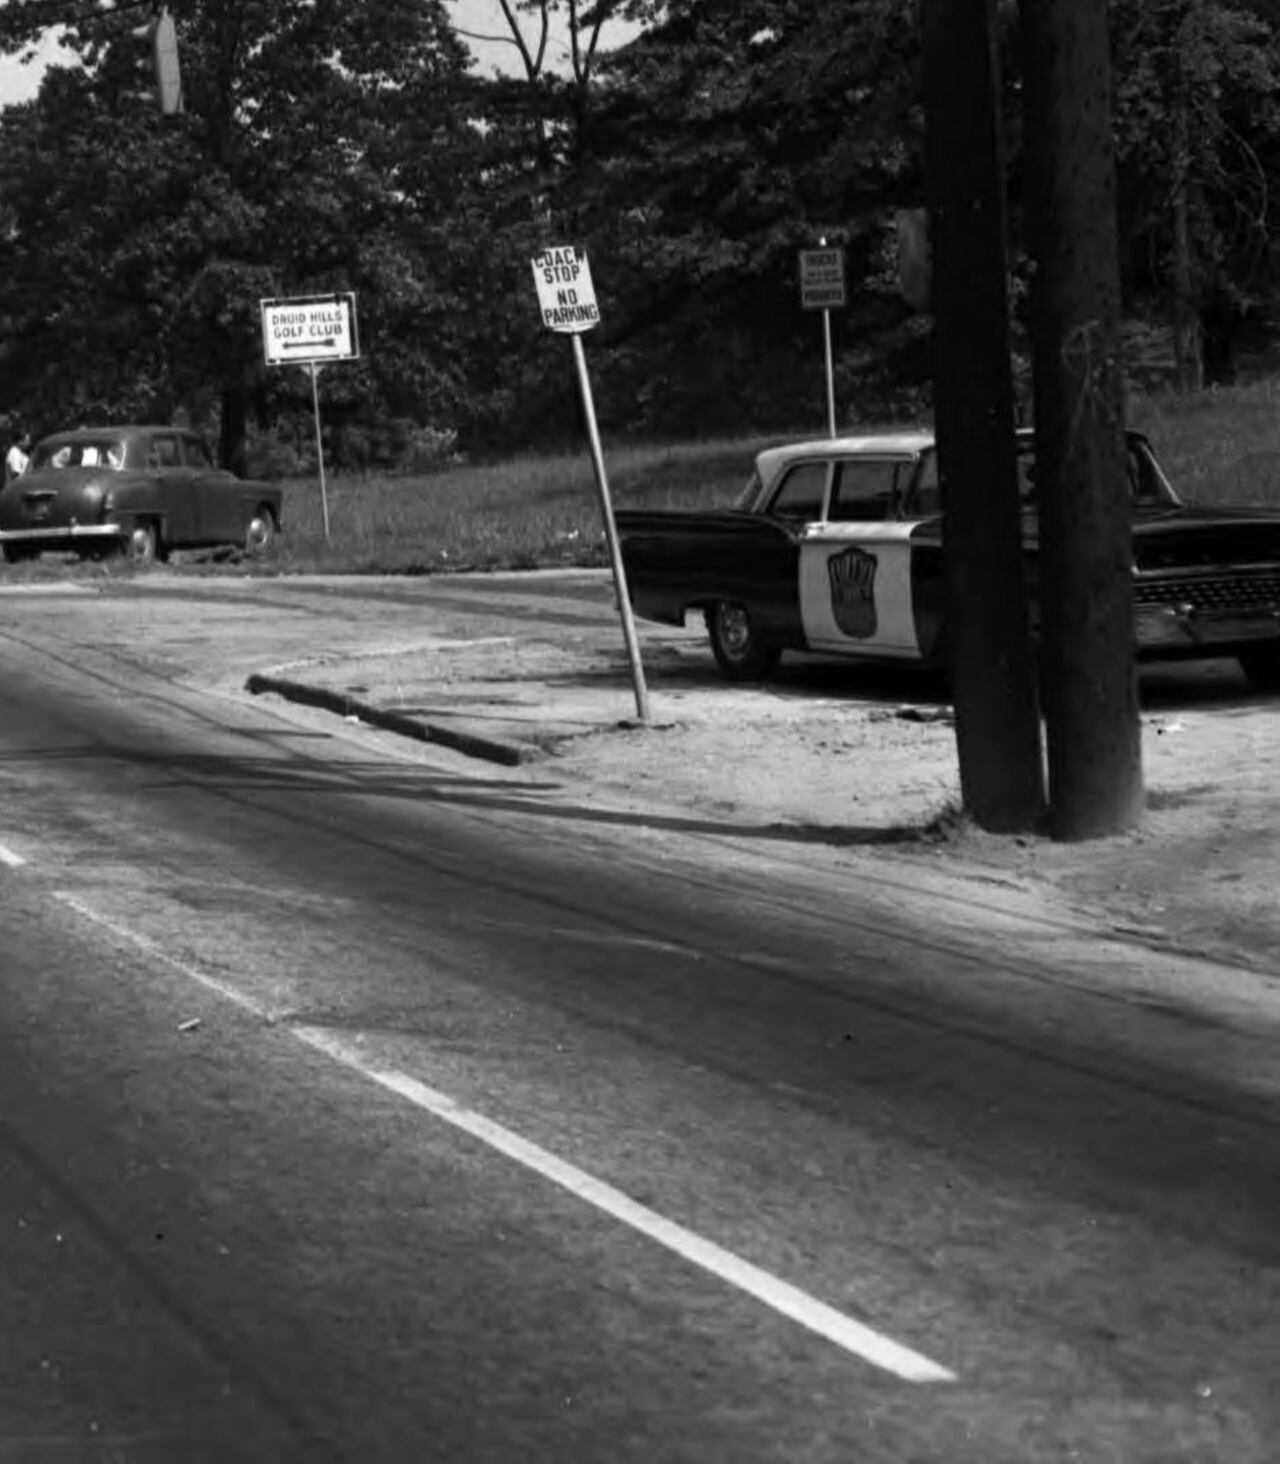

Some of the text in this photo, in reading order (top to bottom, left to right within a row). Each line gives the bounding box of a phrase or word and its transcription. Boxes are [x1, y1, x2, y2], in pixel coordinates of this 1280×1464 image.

[543, 265, 579, 284] STOP
[557, 289, 578, 306] NO
[272, 310, 343, 326] DRUID HILLS
[544, 304, 598, 324] PARKING
[274, 324, 343, 339] GOLF CLUB
